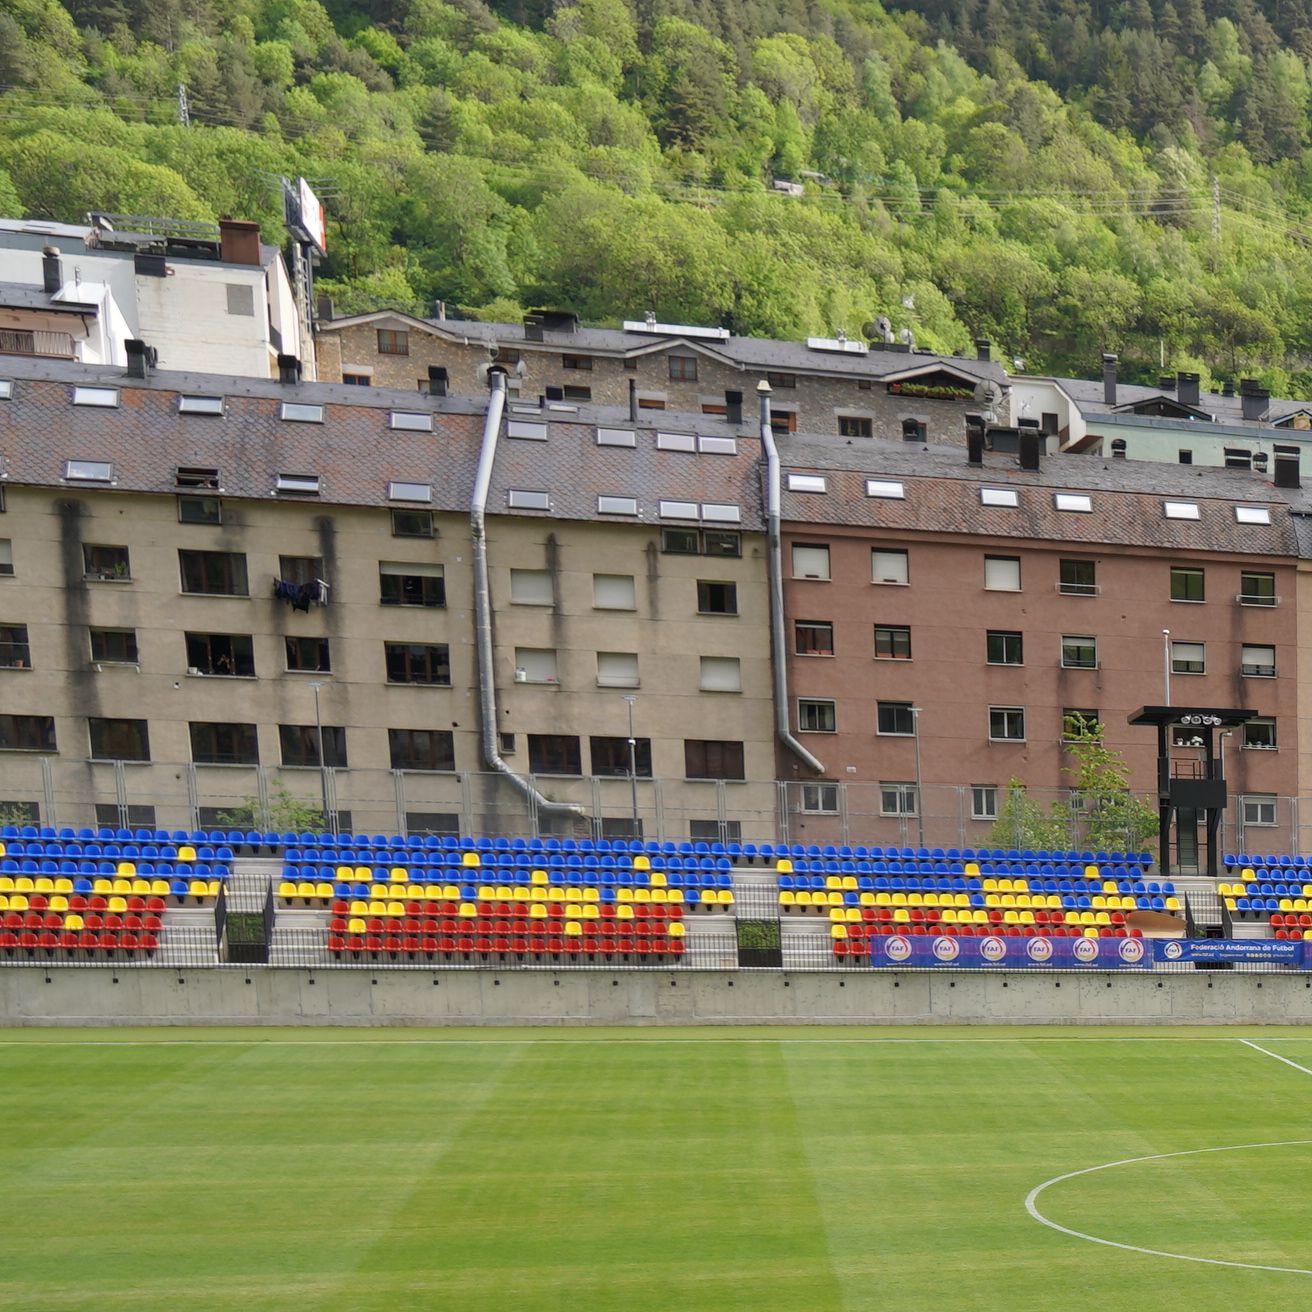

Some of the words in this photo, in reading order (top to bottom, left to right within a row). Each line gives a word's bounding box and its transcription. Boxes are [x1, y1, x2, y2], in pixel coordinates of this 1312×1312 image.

[1190, 944, 1225, 952] Federació
[1226, 944, 1261, 952] Andorrana
[1272, 944, 1295, 952] Futbol
